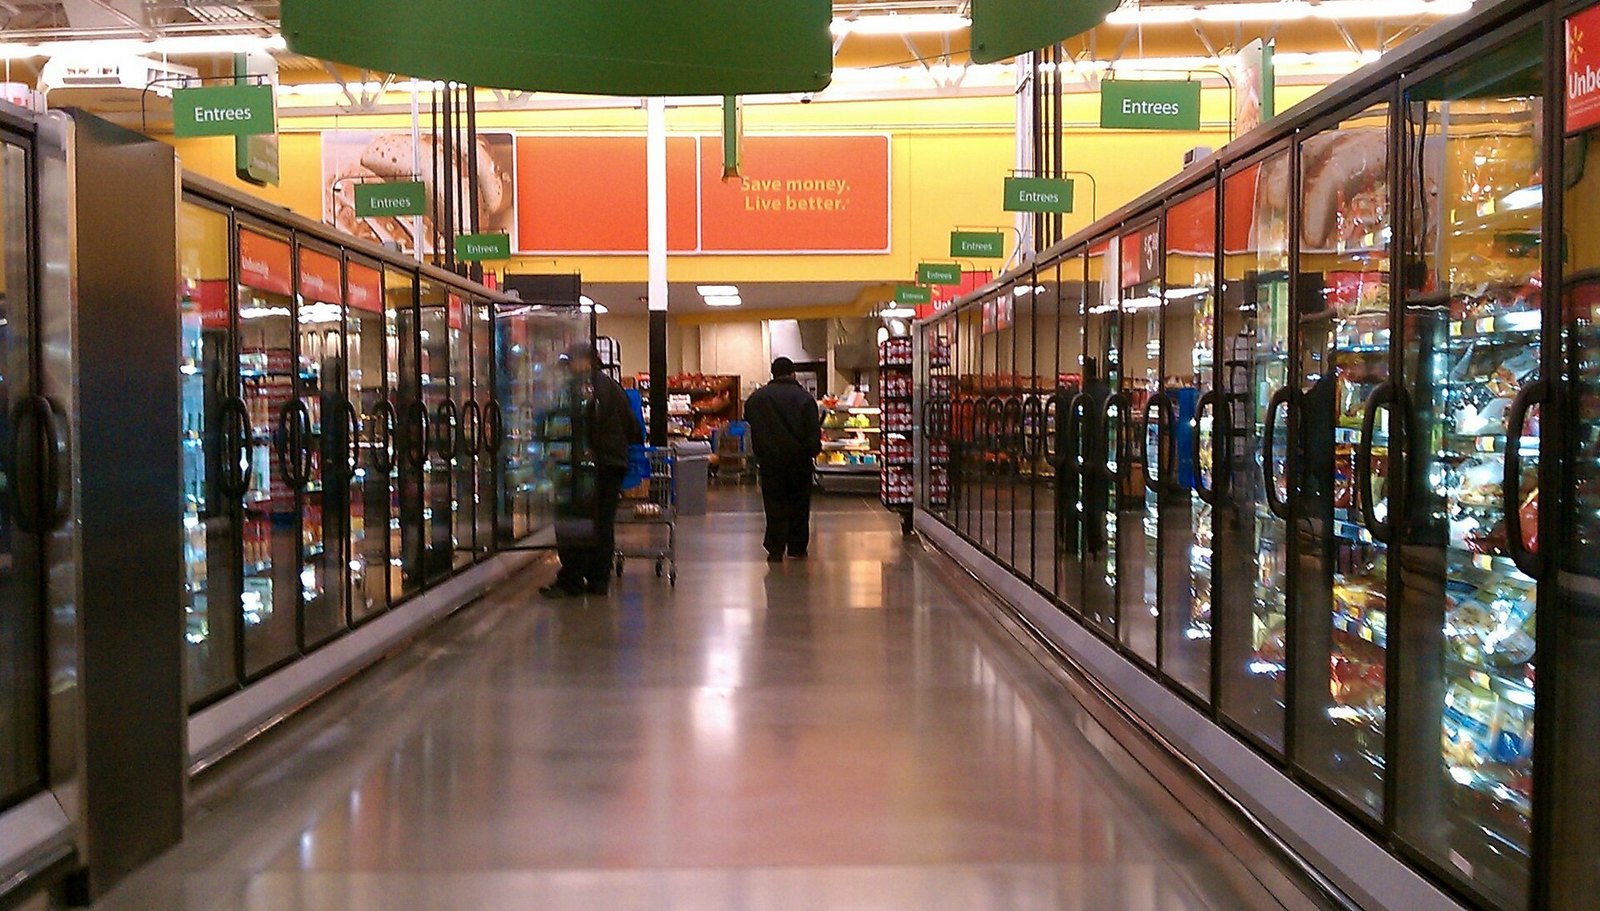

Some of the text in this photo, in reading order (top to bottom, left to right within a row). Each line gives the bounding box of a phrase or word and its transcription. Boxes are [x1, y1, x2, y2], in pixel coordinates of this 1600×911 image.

[1122, 99, 1179, 115] Entrees
[194, 106, 252, 122] Entrees
[741, 176, 851, 195] Save money.
[1019, 190, 1059, 203] Entrees
[370, 197, 411, 209] Entrees
[745, 196, 782, 211] Live
[467, 243, 499, 254] Entrees
[961, 240, 993, 251] Entrees
[926, 271, 952, 280] Entrees
[902, 292, 924, 300] Entrees
